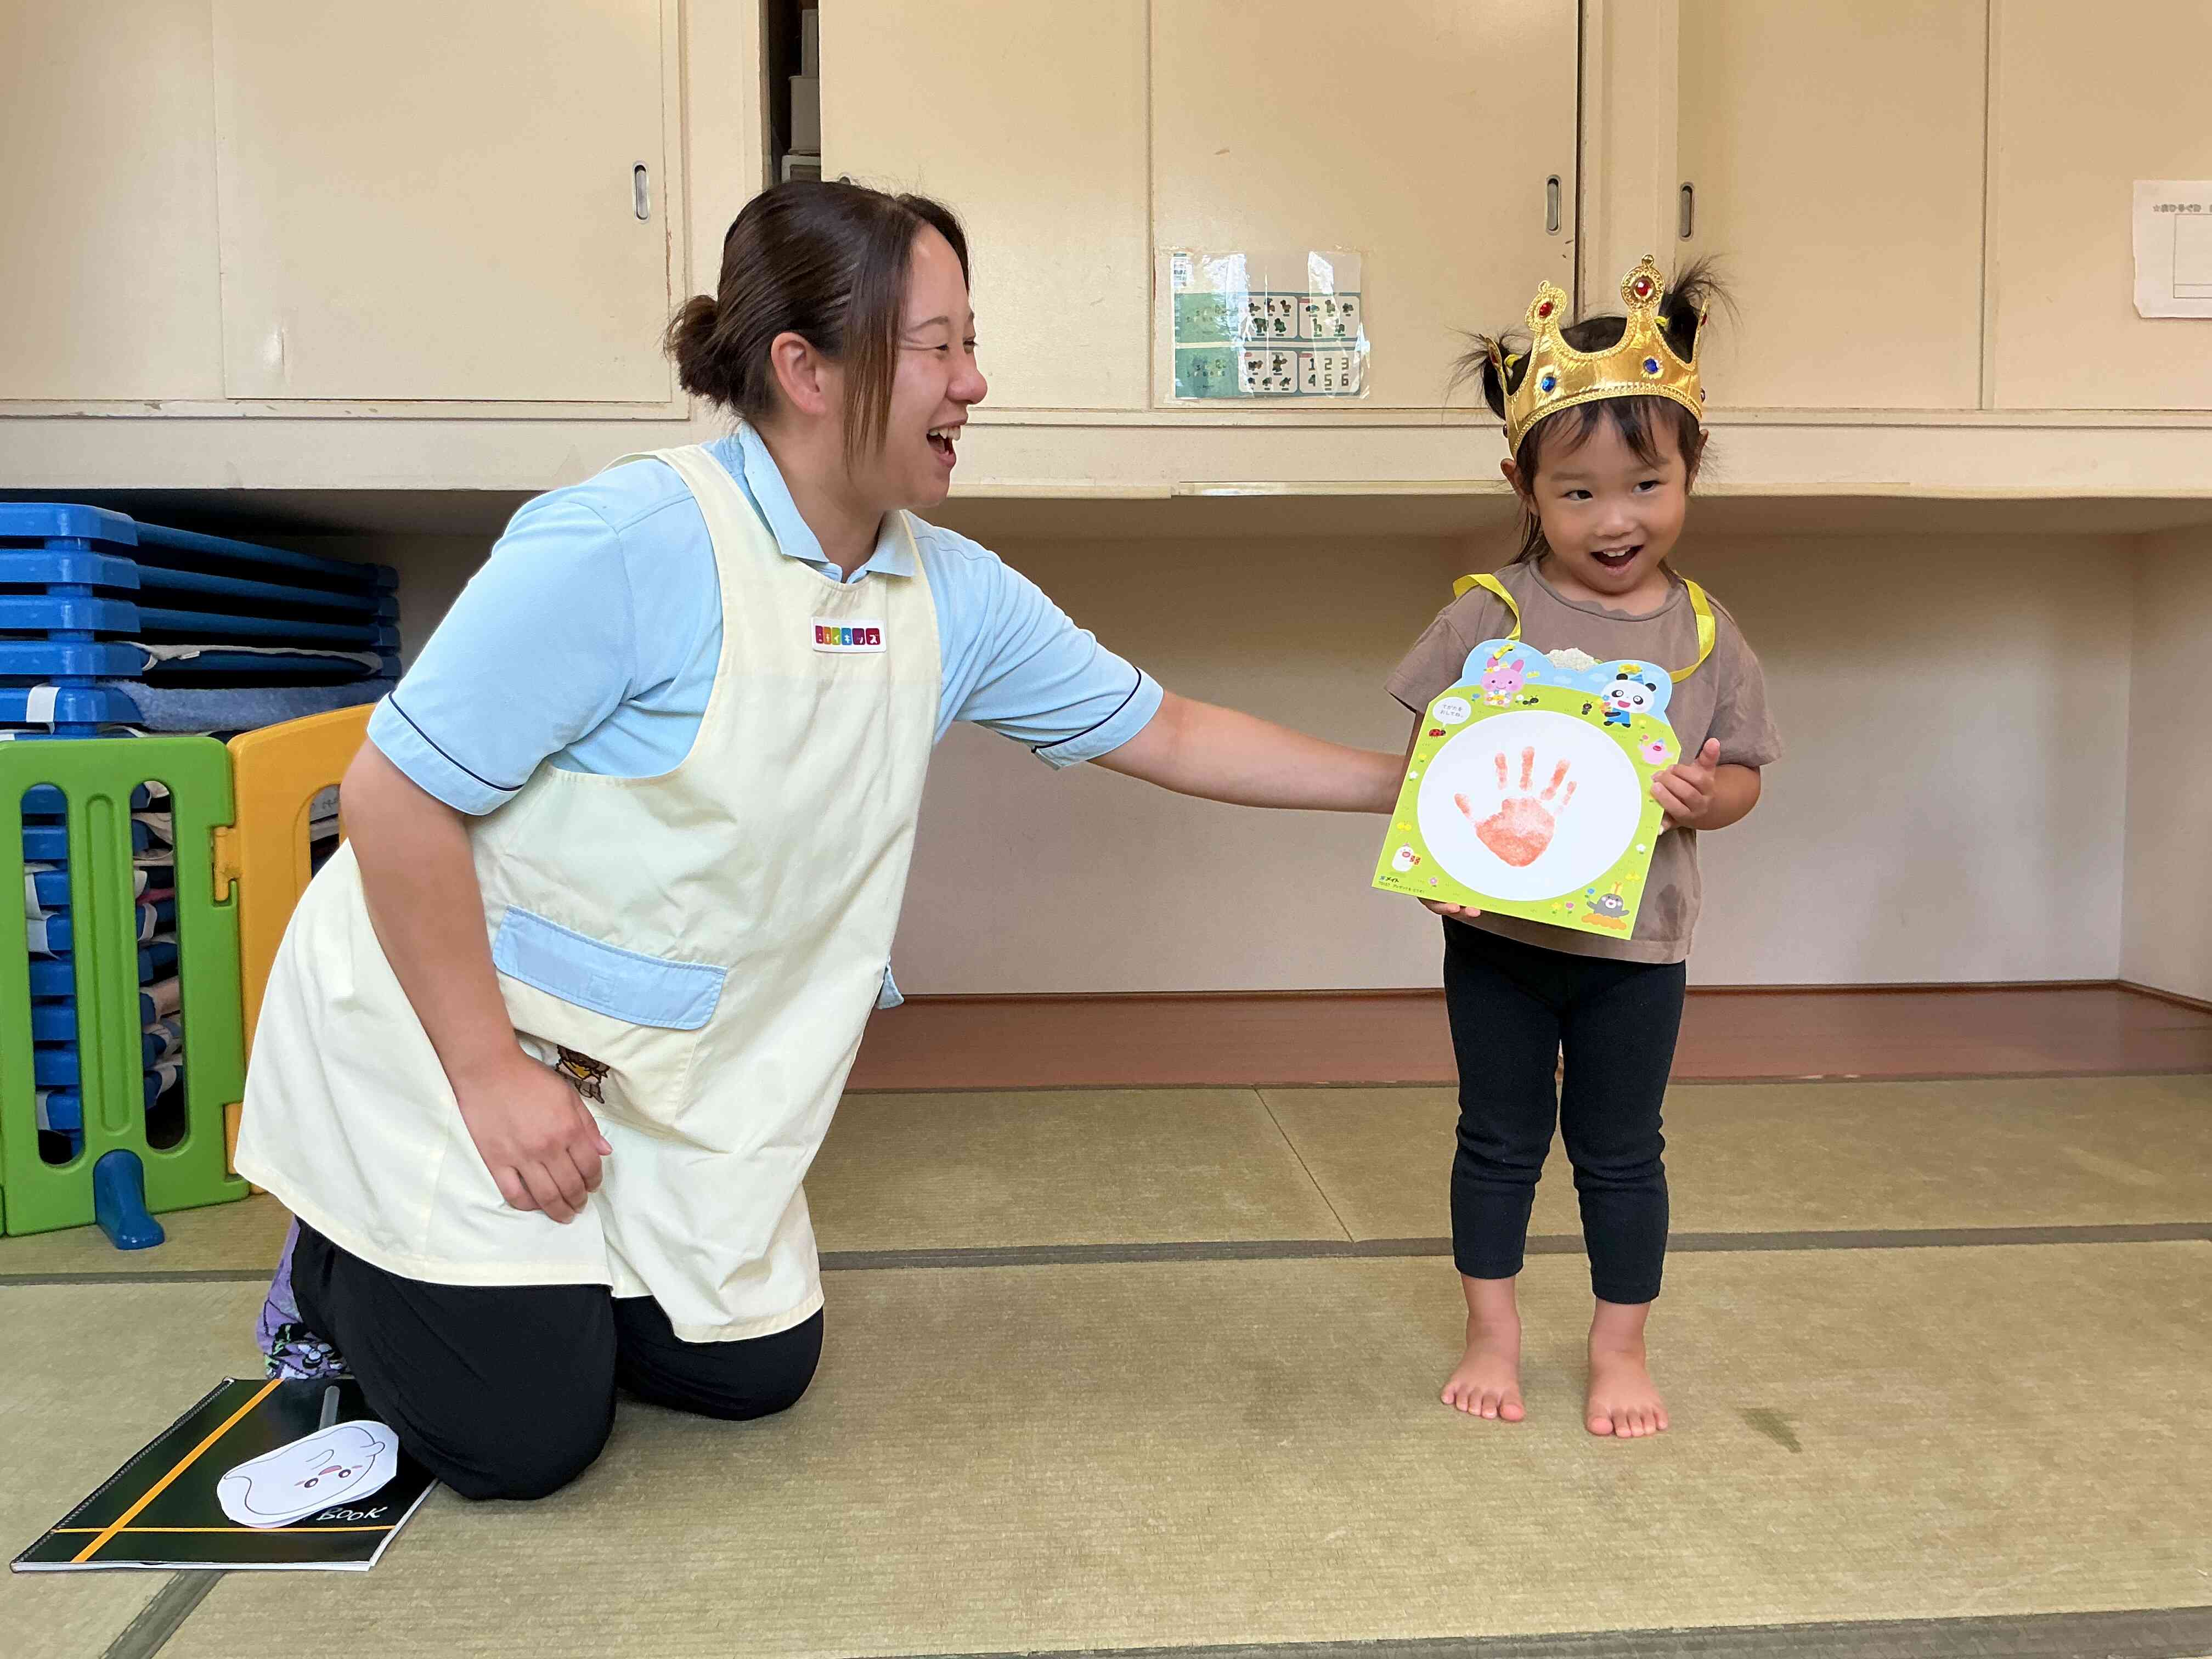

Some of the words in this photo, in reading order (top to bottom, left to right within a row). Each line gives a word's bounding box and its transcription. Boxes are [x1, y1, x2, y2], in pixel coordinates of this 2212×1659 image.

[1308, 358, 1315, 371] 1
[1324, 358, 1332, 370] 2
[1341, 358, 1349, 370] 3
[1308, 374, 1316, 386] 4
[1324, 374, 1332, 386] 5
[1341, 374, 1348, 386] 6
[316, 1506, 388, 1521] BOOK
